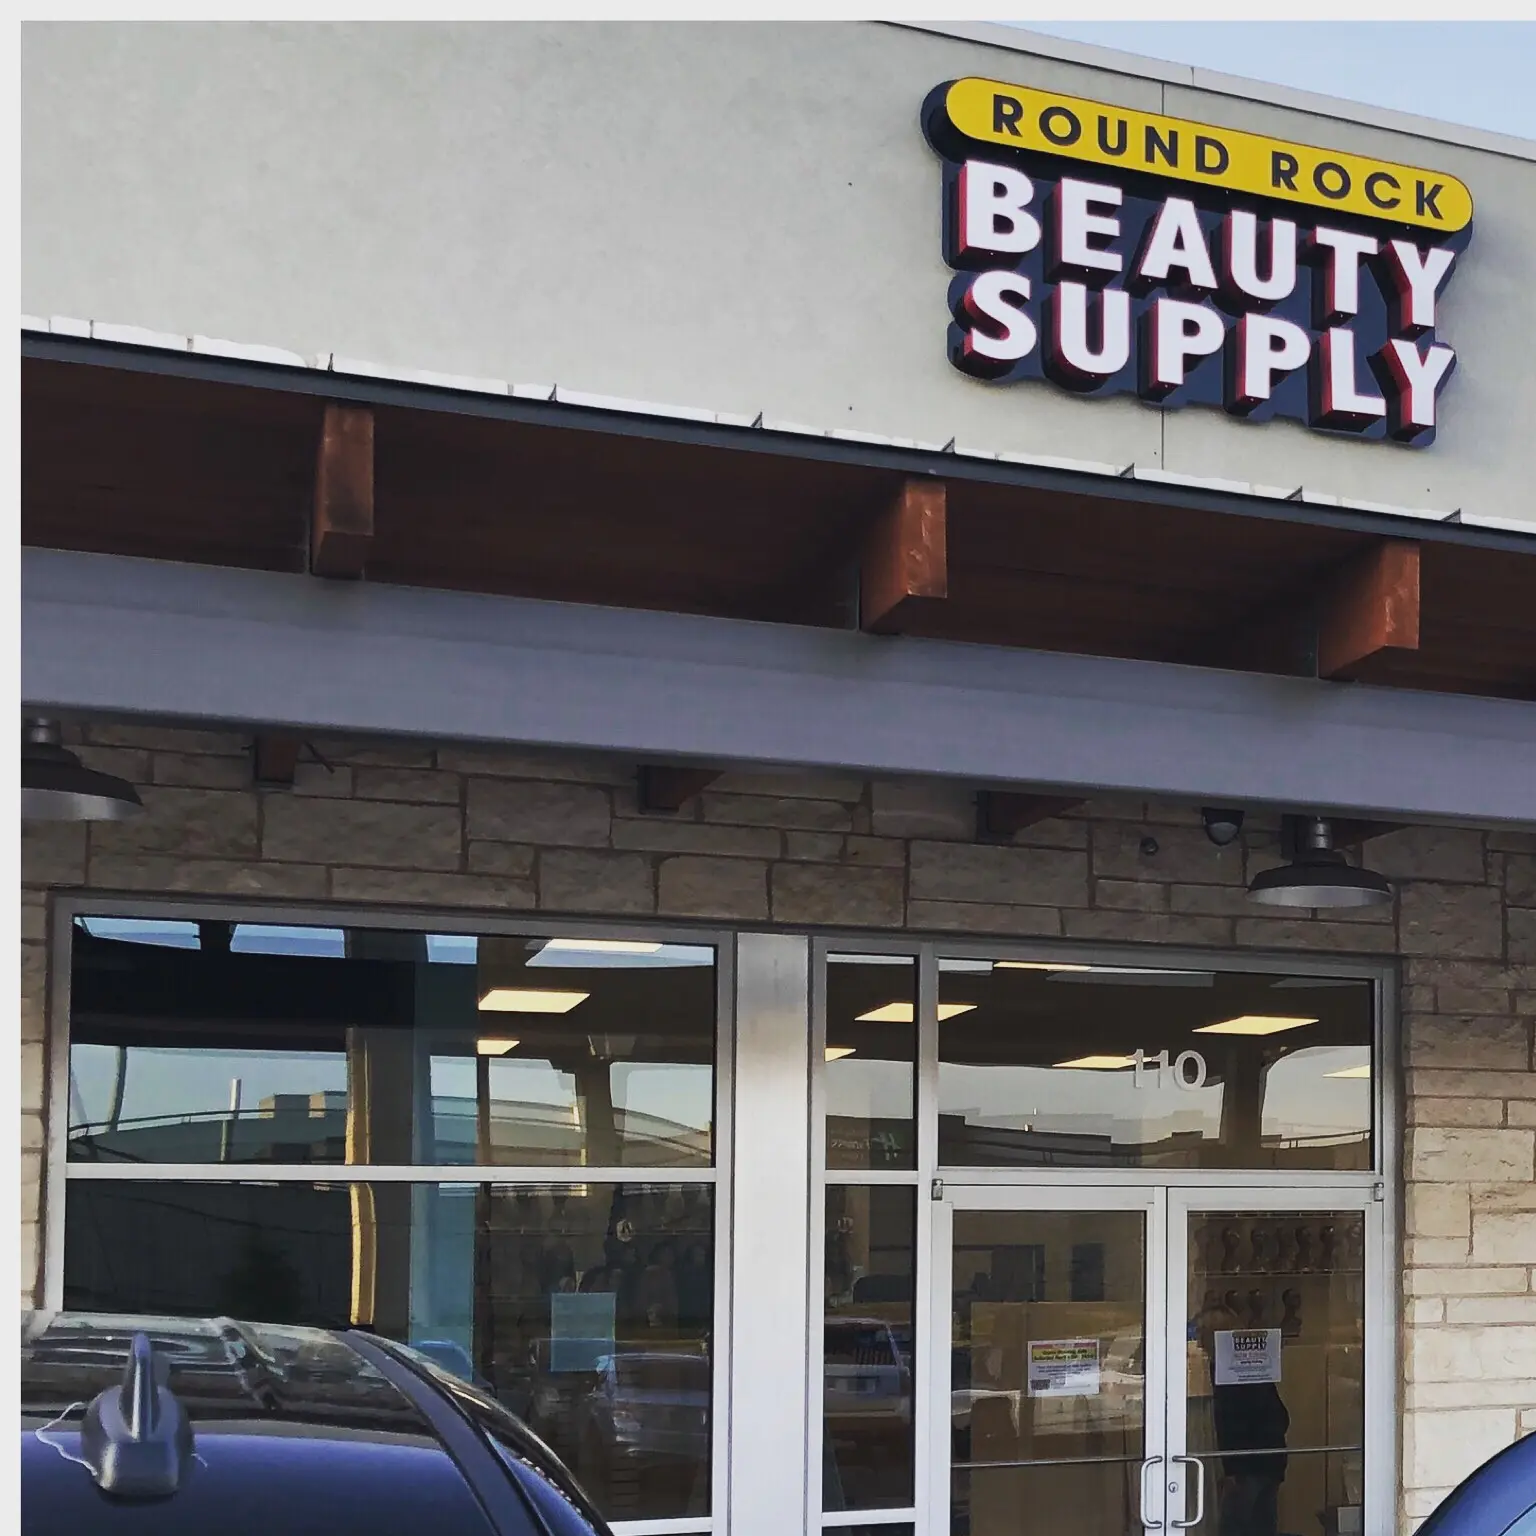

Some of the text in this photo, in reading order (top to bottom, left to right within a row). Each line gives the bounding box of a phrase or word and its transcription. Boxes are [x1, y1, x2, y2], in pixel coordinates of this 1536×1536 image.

[992, 93, 1444, 219] ROUND ROCK
[963, 159, 1455, 328] BEAUTY
[969, 270, 1454, 426] SUPPLY
[1126, 1049, 1207, 1091] 110
